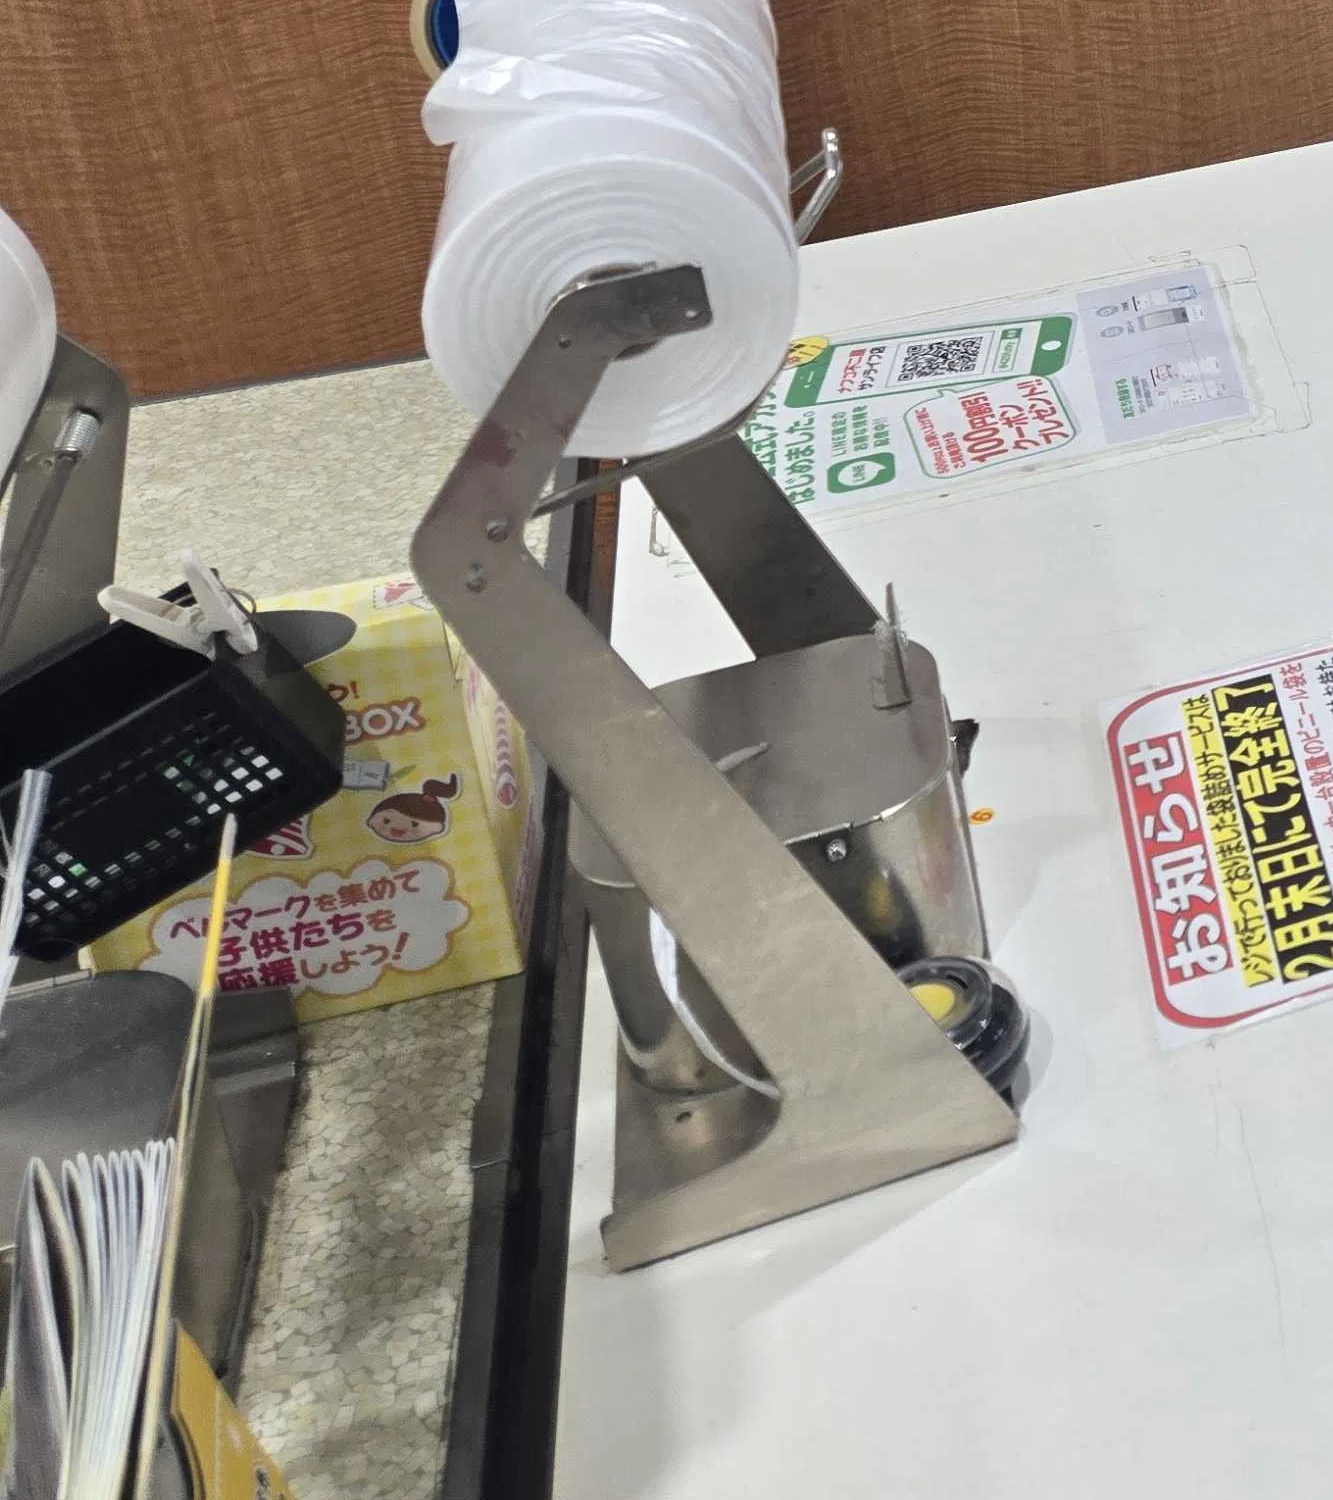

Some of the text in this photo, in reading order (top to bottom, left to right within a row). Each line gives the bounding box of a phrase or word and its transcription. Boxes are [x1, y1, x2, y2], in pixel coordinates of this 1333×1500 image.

[997, 404, 1030, 451] クーポン
[1120, 732, 1235, 985] お知らせ
[1177, 693, 1280, 989] レジで行っておりました袋詰めサービスは
